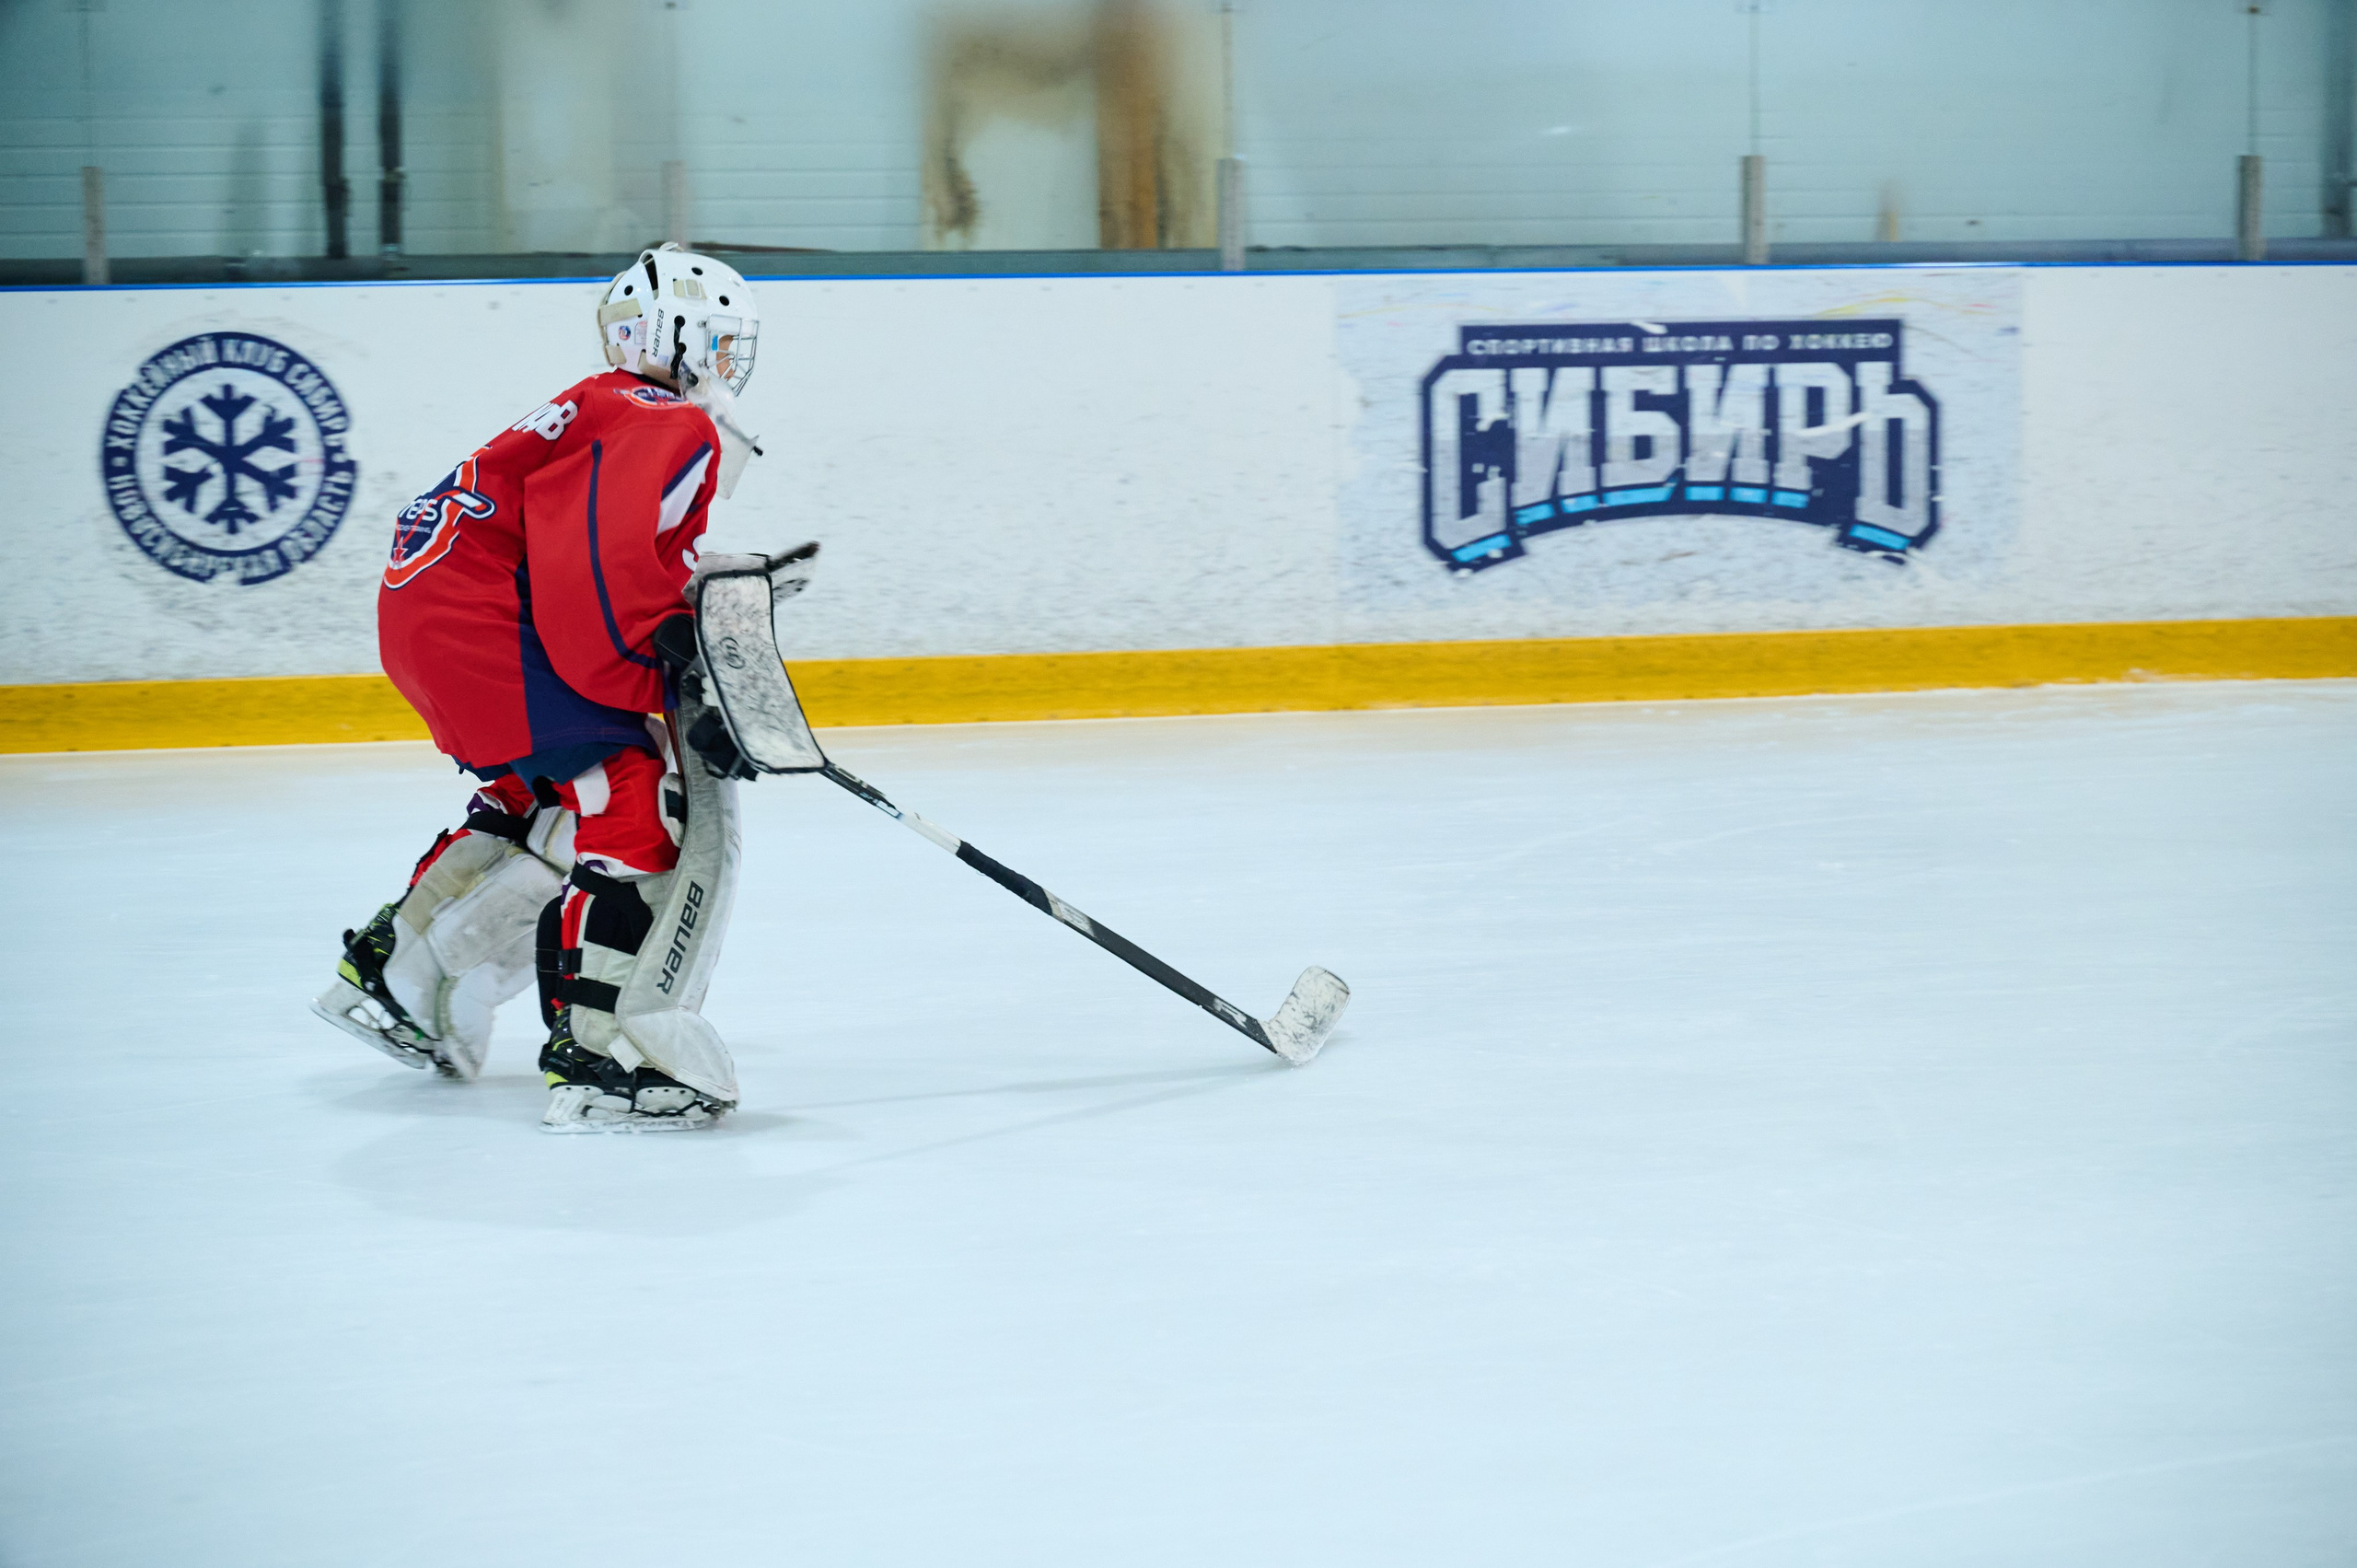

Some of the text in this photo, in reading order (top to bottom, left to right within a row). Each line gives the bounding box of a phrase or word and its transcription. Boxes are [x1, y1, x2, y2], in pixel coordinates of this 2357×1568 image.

[222, 338, 291, 373] КЛУБ
[651, 308, 665, 357] BAUER
[1466, 332, 1894, 355] СПОРТИВНАЯ ШКОЛА ПО ХОККЕЮ
[1430, 360, 1932, 551] СИБИРЬ
[656, 879, 704, 995] BAUER
